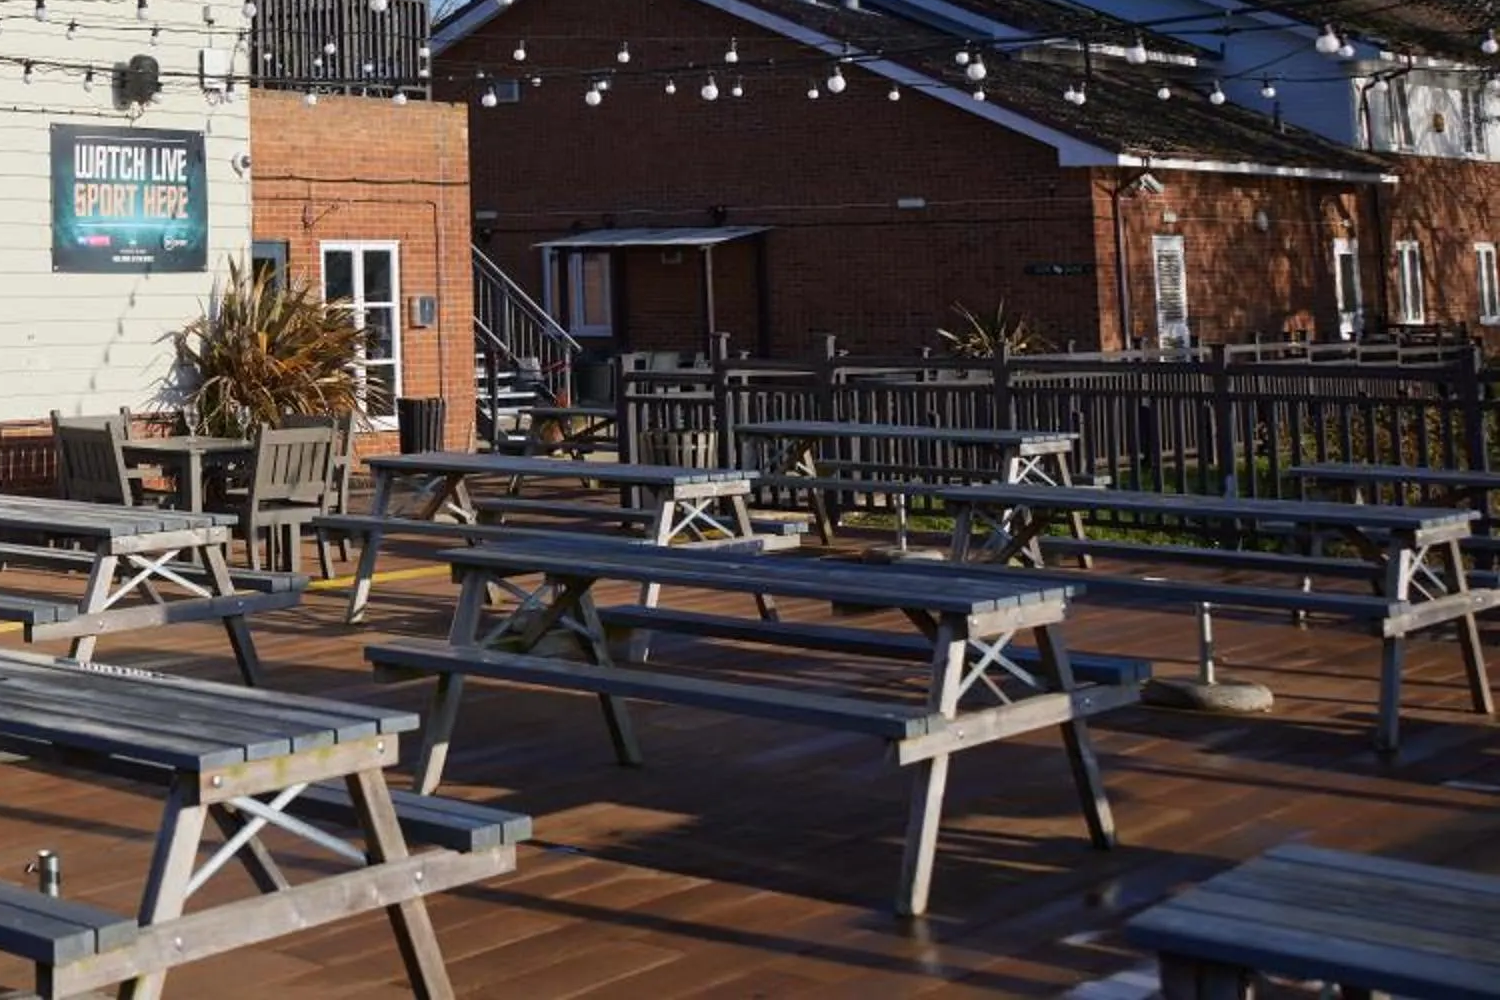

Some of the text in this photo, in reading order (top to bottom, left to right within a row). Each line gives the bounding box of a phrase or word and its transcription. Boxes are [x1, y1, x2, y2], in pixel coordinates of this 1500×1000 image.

[74, 144, 188, 182] WATCH LIVE
[74, 183, 189, 219] SPORT HERE
